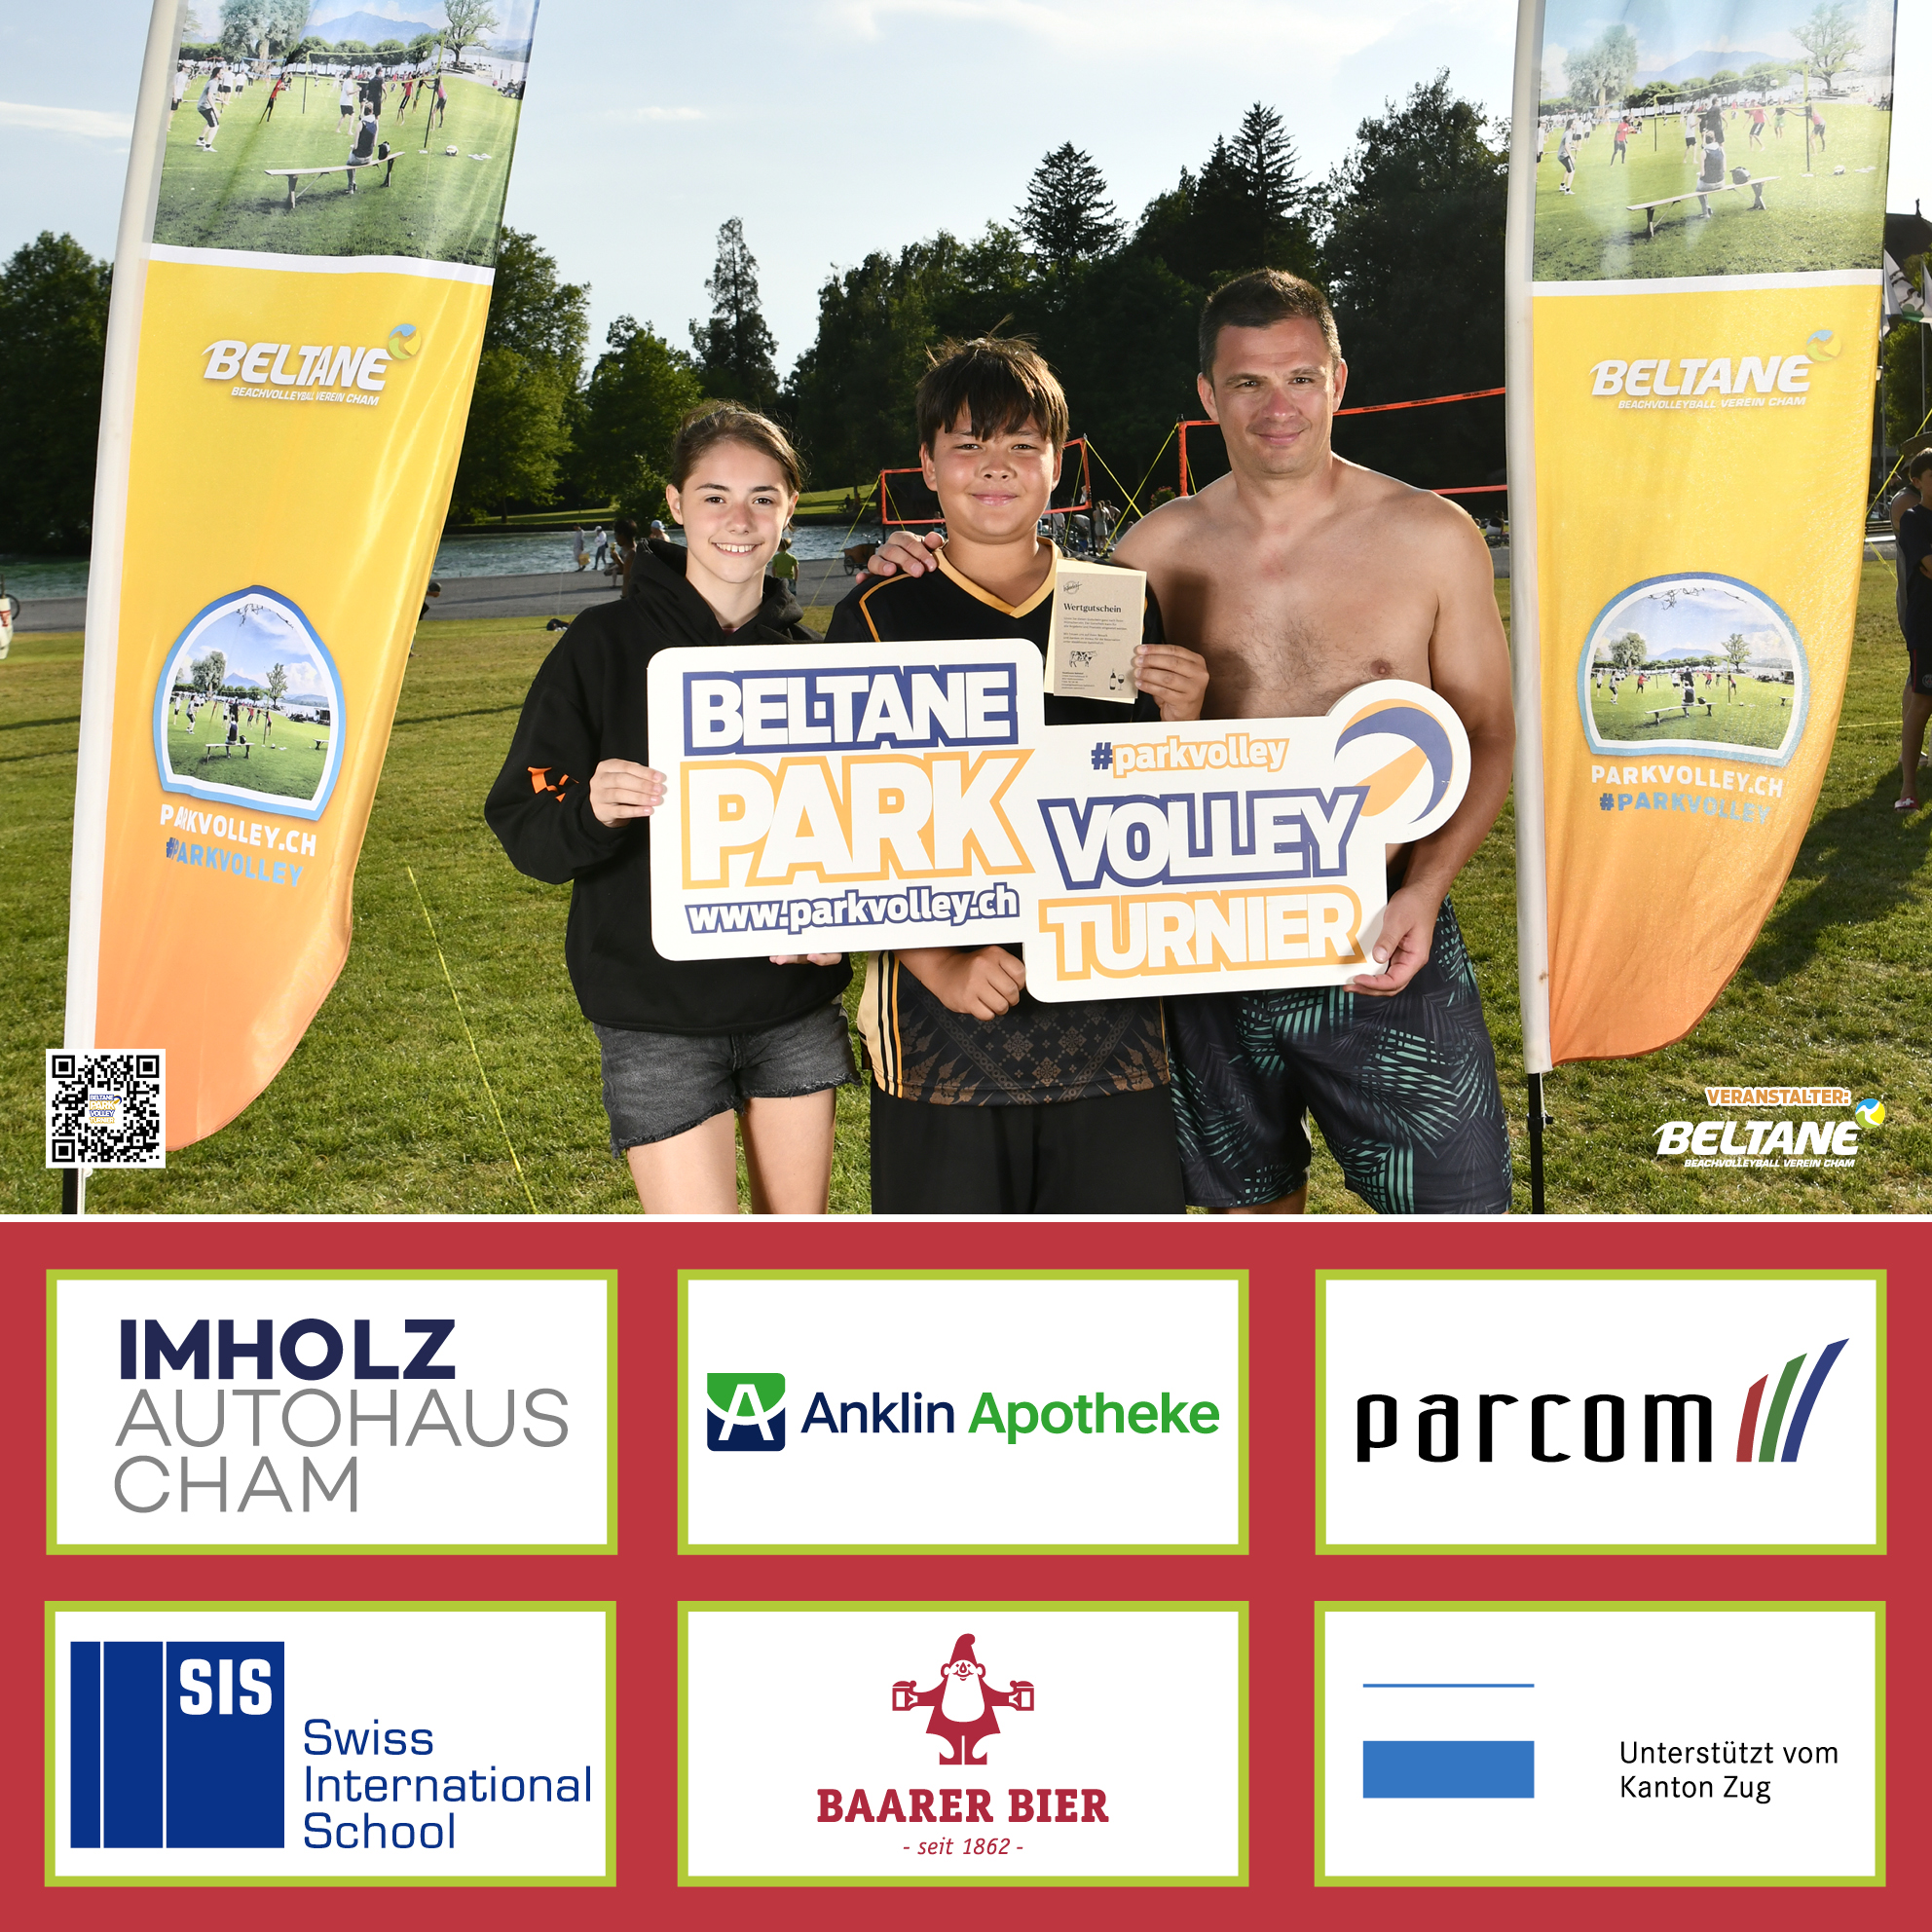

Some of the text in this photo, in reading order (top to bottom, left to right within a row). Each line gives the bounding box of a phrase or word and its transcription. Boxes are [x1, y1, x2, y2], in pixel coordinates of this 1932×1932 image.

[201, 339, 393, 391] BELTANE
[1588, 354, 1814, 396] BELTANE
[231, 387, 380, 406] BEACHVOLLEYBALL VEREIN CHAM
[1618, 396, 1806, 409] BEACHVOLLEYBALL VEREIN CHAM
[1063, 603, 1122, 613] Wertgutschein
[683, 663, 1019, 756] BELTANE
[1091, 732, 1290, 778] #parkvolley
[1591, 764, 1783, 799] PARKVOLLEY.CH
[160, 803, 316, 857] PARKVOLLEY.CH
[680, 749, 1035, 889] PARK
[1599, 792, 1771, 825] #PARKVOLLEY
[166, 836, 304, 887] #PARKVOLLEY
[1038, 785, 1371, 890] VOLLEY
[685, 882, 1020, 935] www.parkvolley.ch
[1038, 884, 1366, 981] TURNIER
